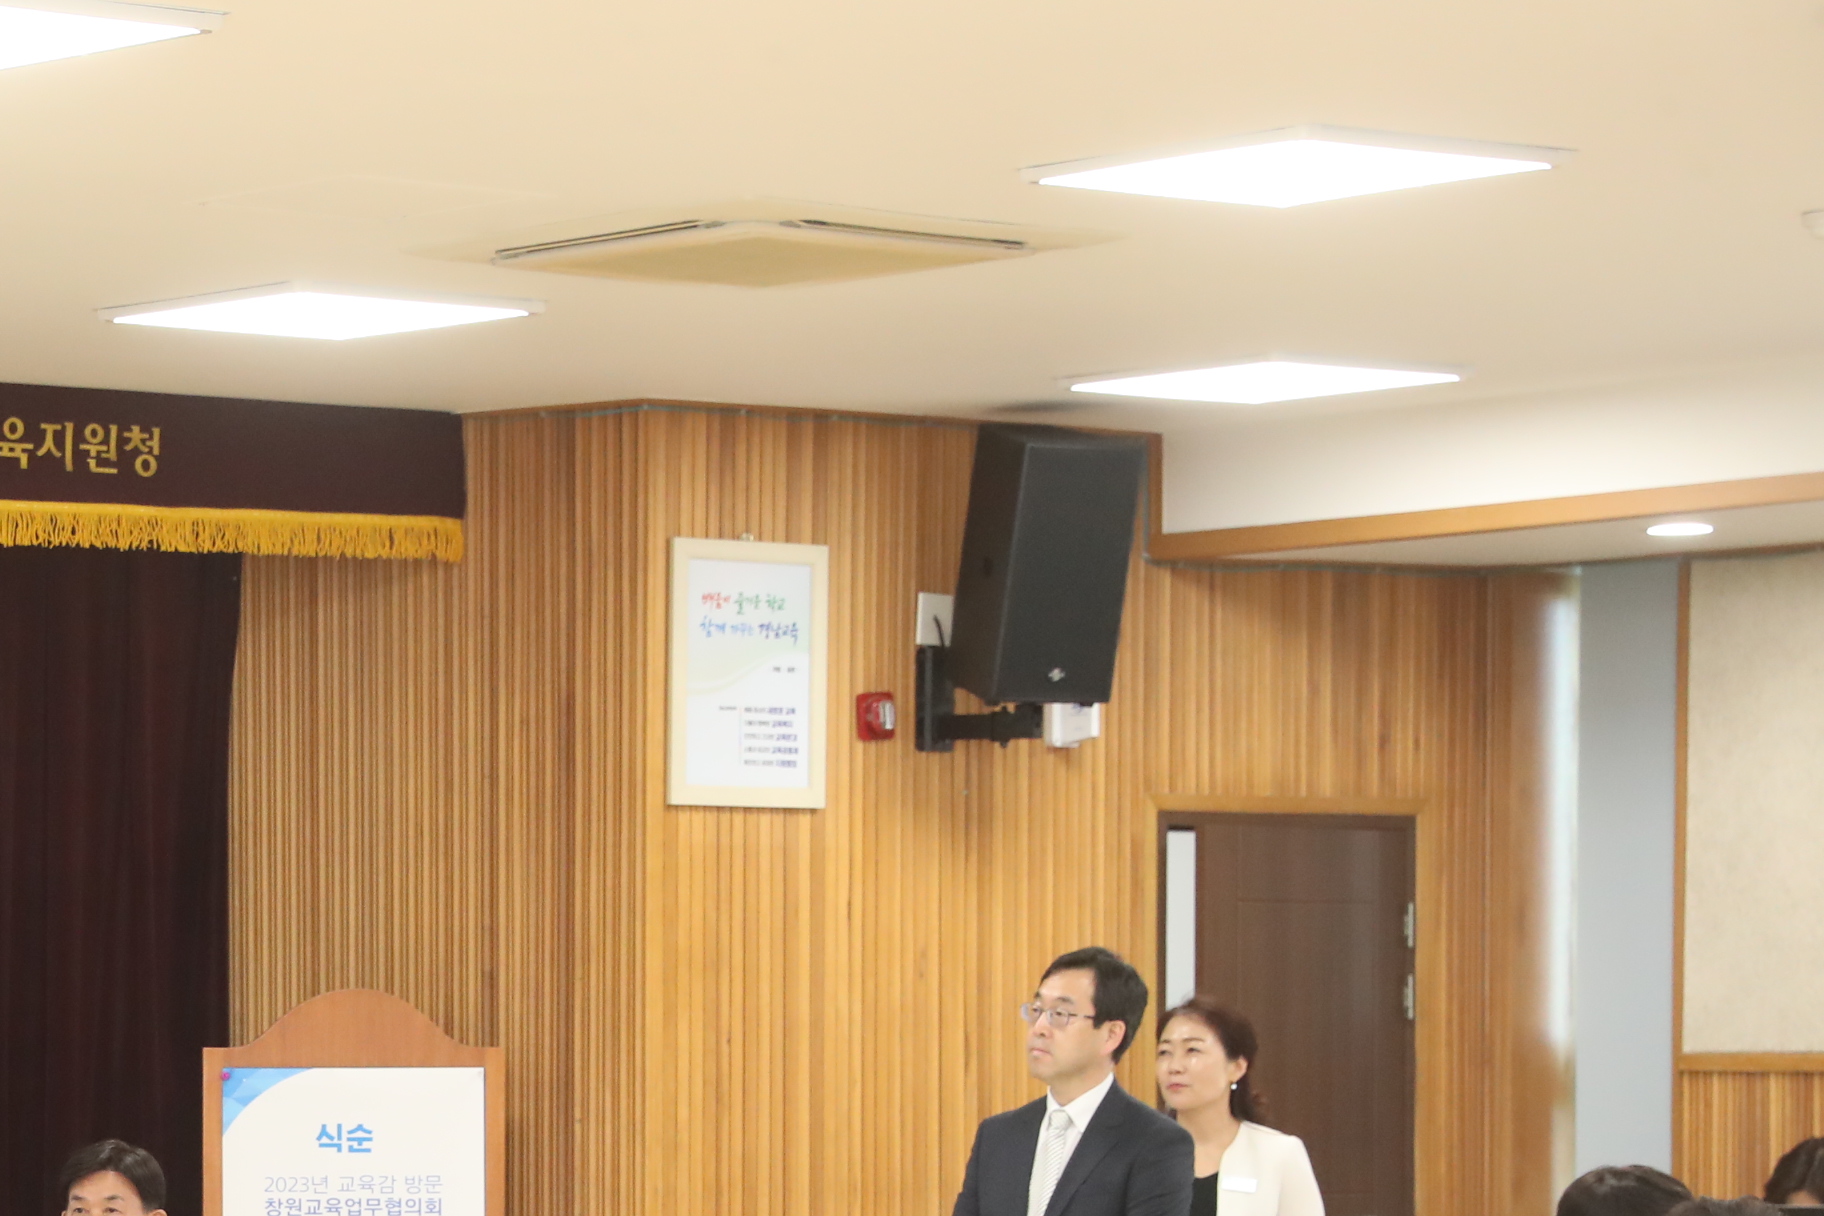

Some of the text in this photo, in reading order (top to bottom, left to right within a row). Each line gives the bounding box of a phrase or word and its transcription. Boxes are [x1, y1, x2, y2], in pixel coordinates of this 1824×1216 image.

[316, 1123, 374, 1153] 식순
[264, 1174, 443, 1194] 2023년 교육감 방문
[264, 1197, 444, 1216] 창원교육업무협의회
